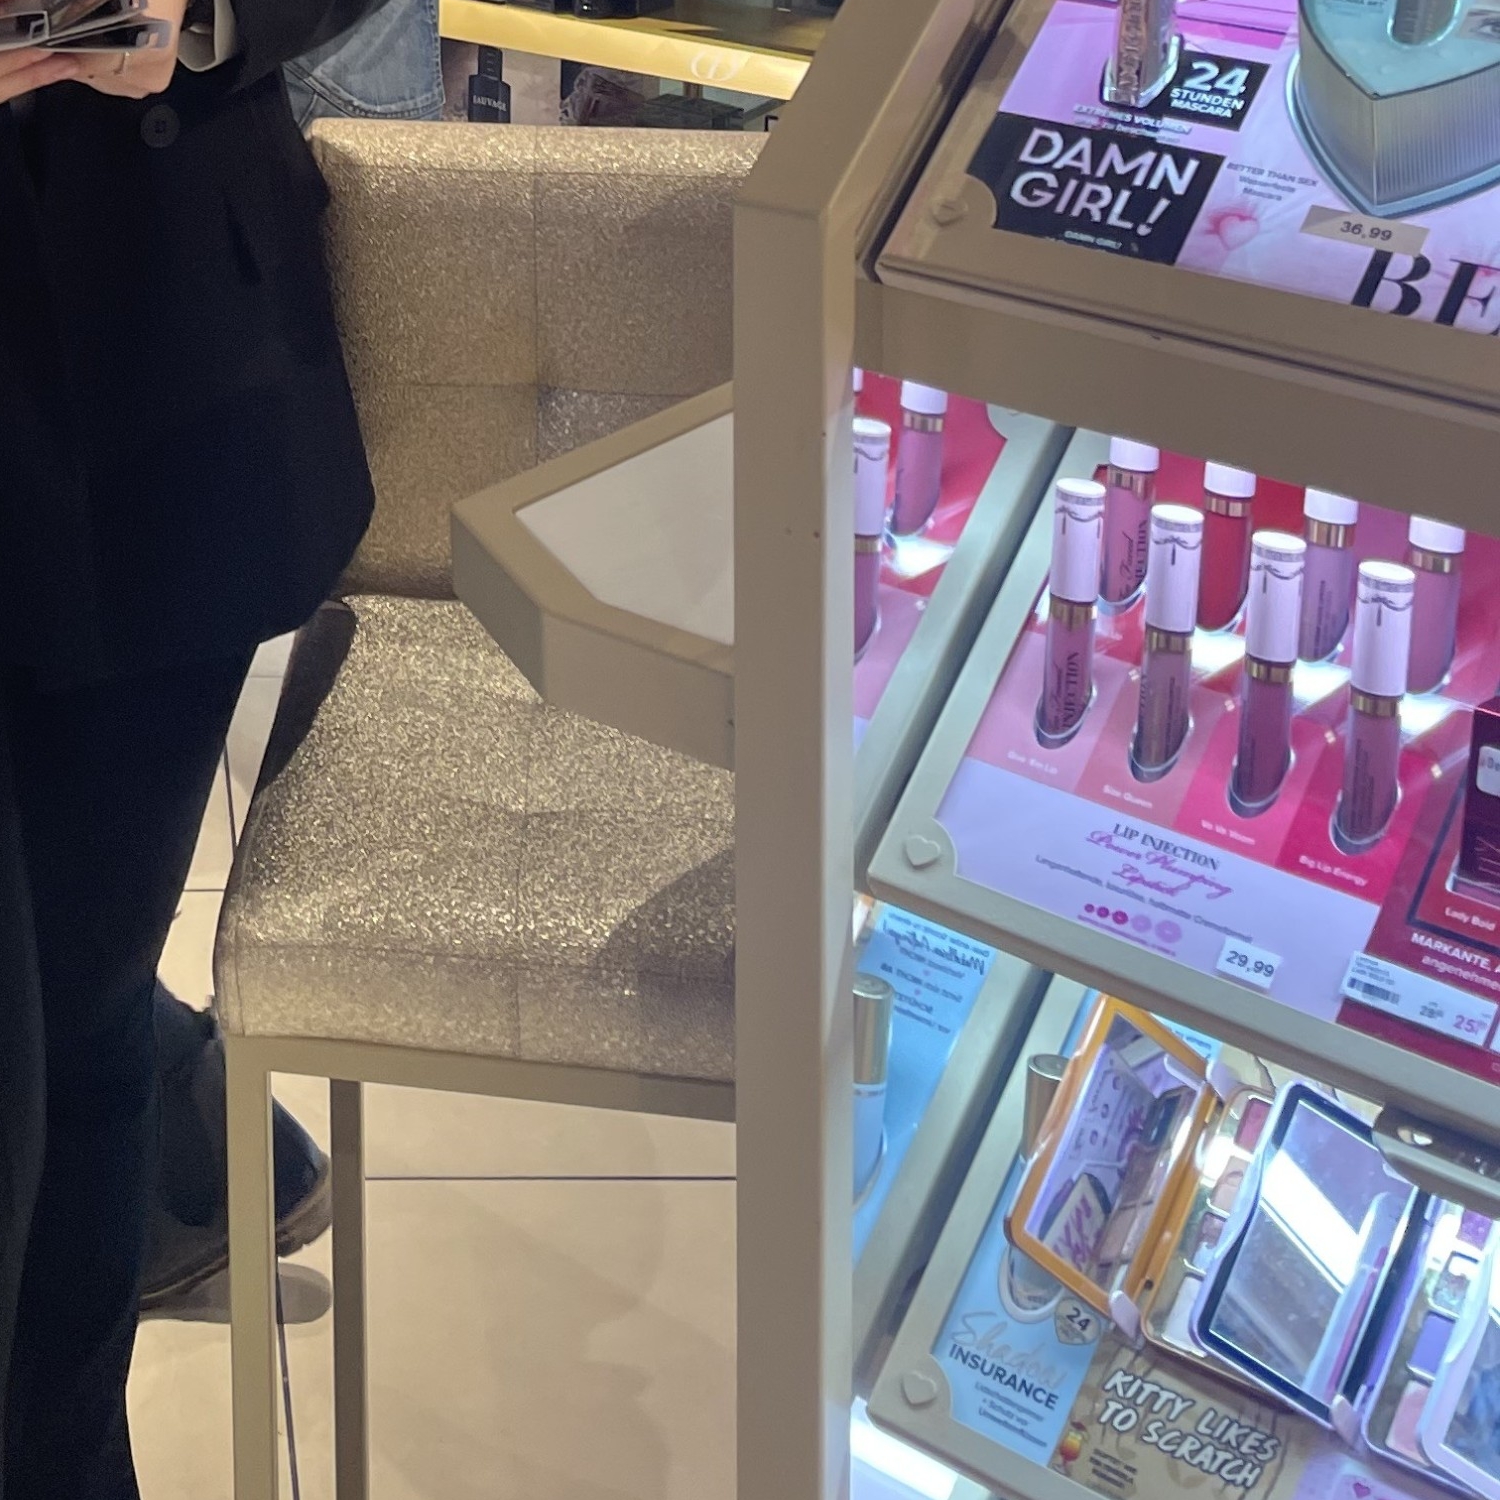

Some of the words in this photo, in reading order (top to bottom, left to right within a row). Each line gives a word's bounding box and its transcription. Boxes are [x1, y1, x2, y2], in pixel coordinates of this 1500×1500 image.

[1170, 87, 1245, 111] STUNDEN
[1184, 61, 1250, 96] 24
[1134, 114, 1192, 135] VOLUMEN
[1171, 99, 1233, 118] MASCARA
[1018, 127, 1200, 196] DAMN
[1010, 170, 1172, 237] GIRL!
[1112, 822, 1139, 842] LIP
[1140, 831, 1221, 871] INJECTION
[1065, 1306, 1091, 1332] 24
[949, 1344, 1059, 1411] INSURANCE
[1099, 1399, 1139, 1433] TO
[1103, 1369, 1195, 1421] KITTY
[1195, 1407, 1281, 1463] LIKES
[1142, 1420, 1262, 1488] SCRATCH
